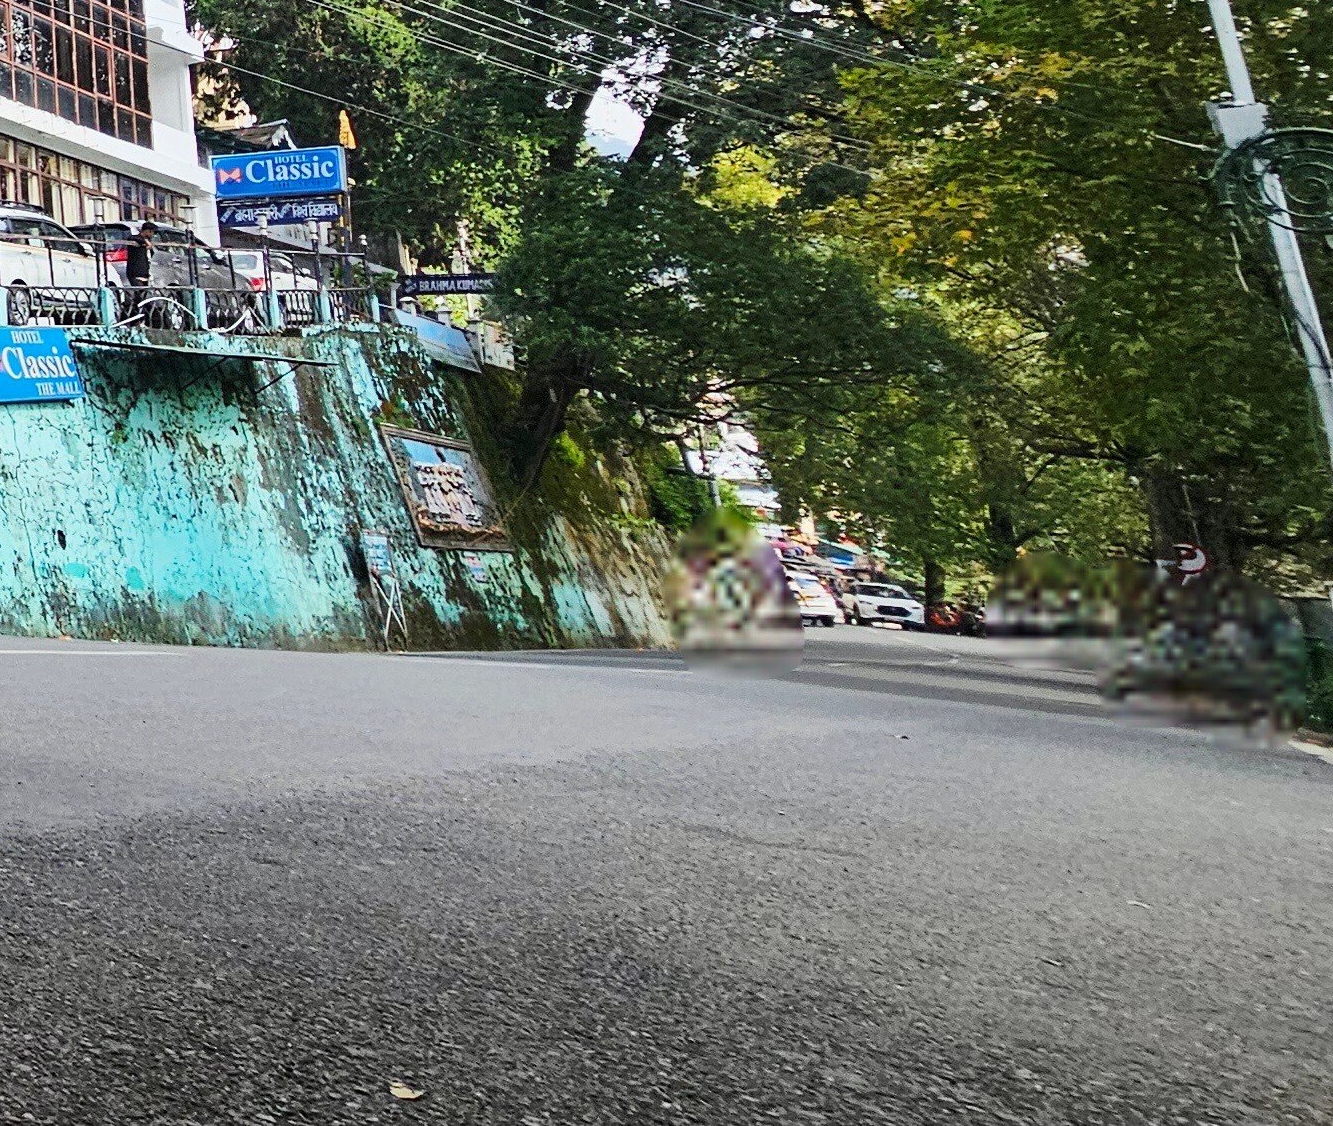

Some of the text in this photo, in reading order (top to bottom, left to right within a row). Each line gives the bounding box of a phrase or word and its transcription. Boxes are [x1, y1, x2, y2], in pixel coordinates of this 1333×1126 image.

[274, 154, 309, 164] HOTEL
[245, 155, 335, 183] Classic
[419, 280, 456, 292] BRAHMA
[10, 330, 44, 344] HOTEL
[1, 346, 76, 379] Classic
[35, 381, 82, 396] THE MALL
